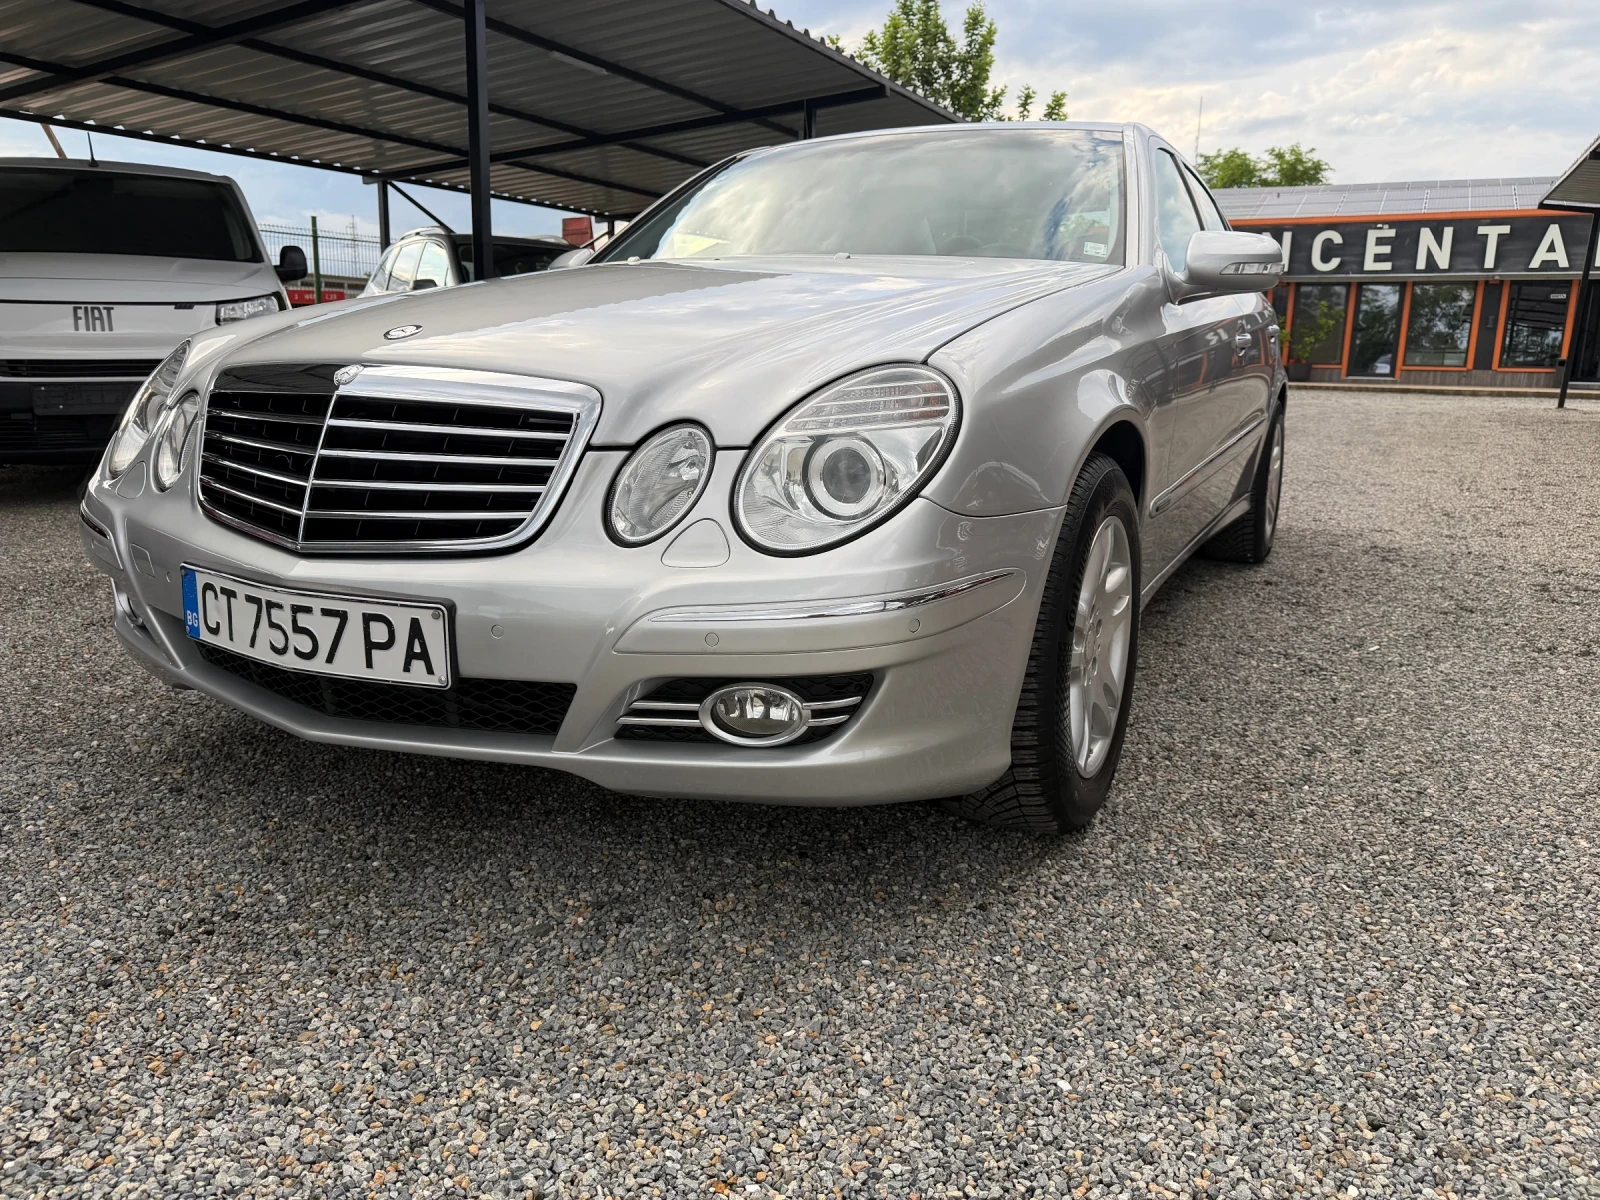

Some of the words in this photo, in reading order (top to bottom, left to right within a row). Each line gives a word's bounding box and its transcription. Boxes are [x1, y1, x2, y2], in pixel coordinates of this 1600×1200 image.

[1262, 223, 1600, 272] CENTA
[73, 306, 114, 331] FIAT
[187, 610, 198, 627] BG
